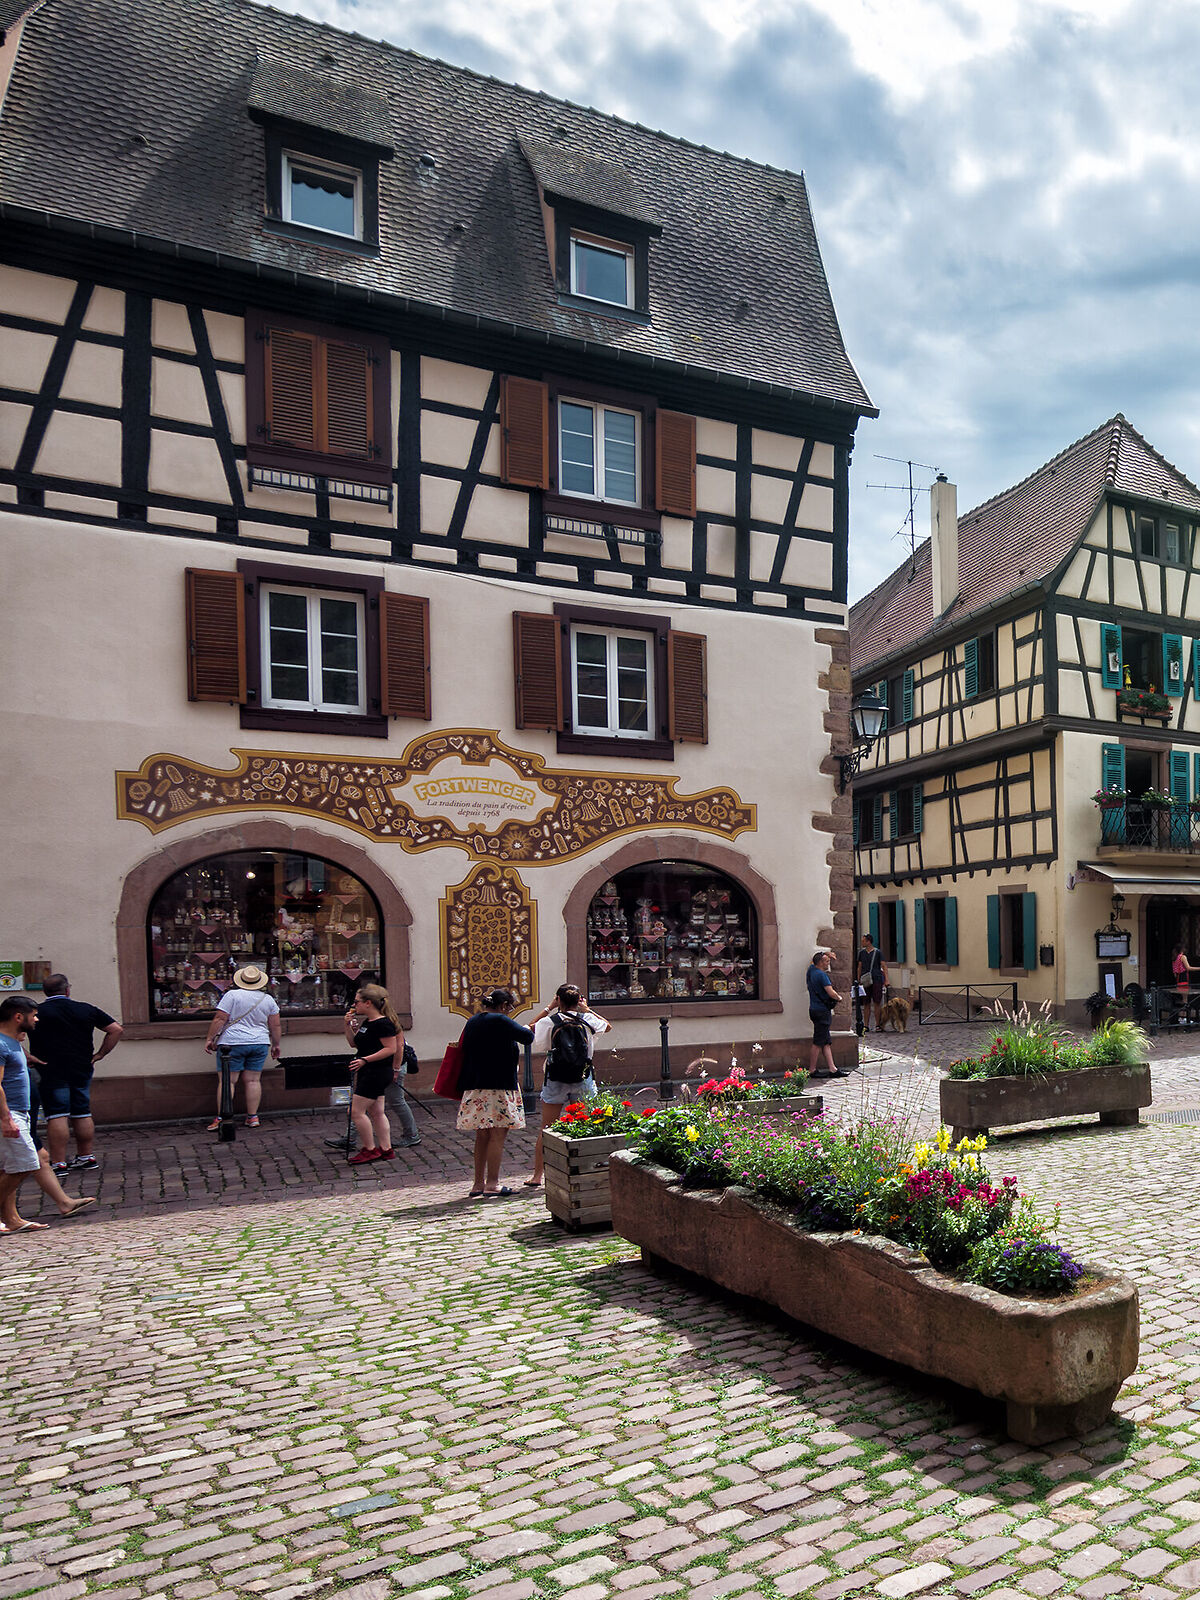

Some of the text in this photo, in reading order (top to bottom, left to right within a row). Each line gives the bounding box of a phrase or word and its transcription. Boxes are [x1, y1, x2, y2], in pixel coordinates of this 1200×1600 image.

[413, 777, 536, 806] FORTWENGER
[439, 800, 470, 808] tradition
[483, 802, 498, 810] pain
[457, 809, 500, 818] depuis 1768
